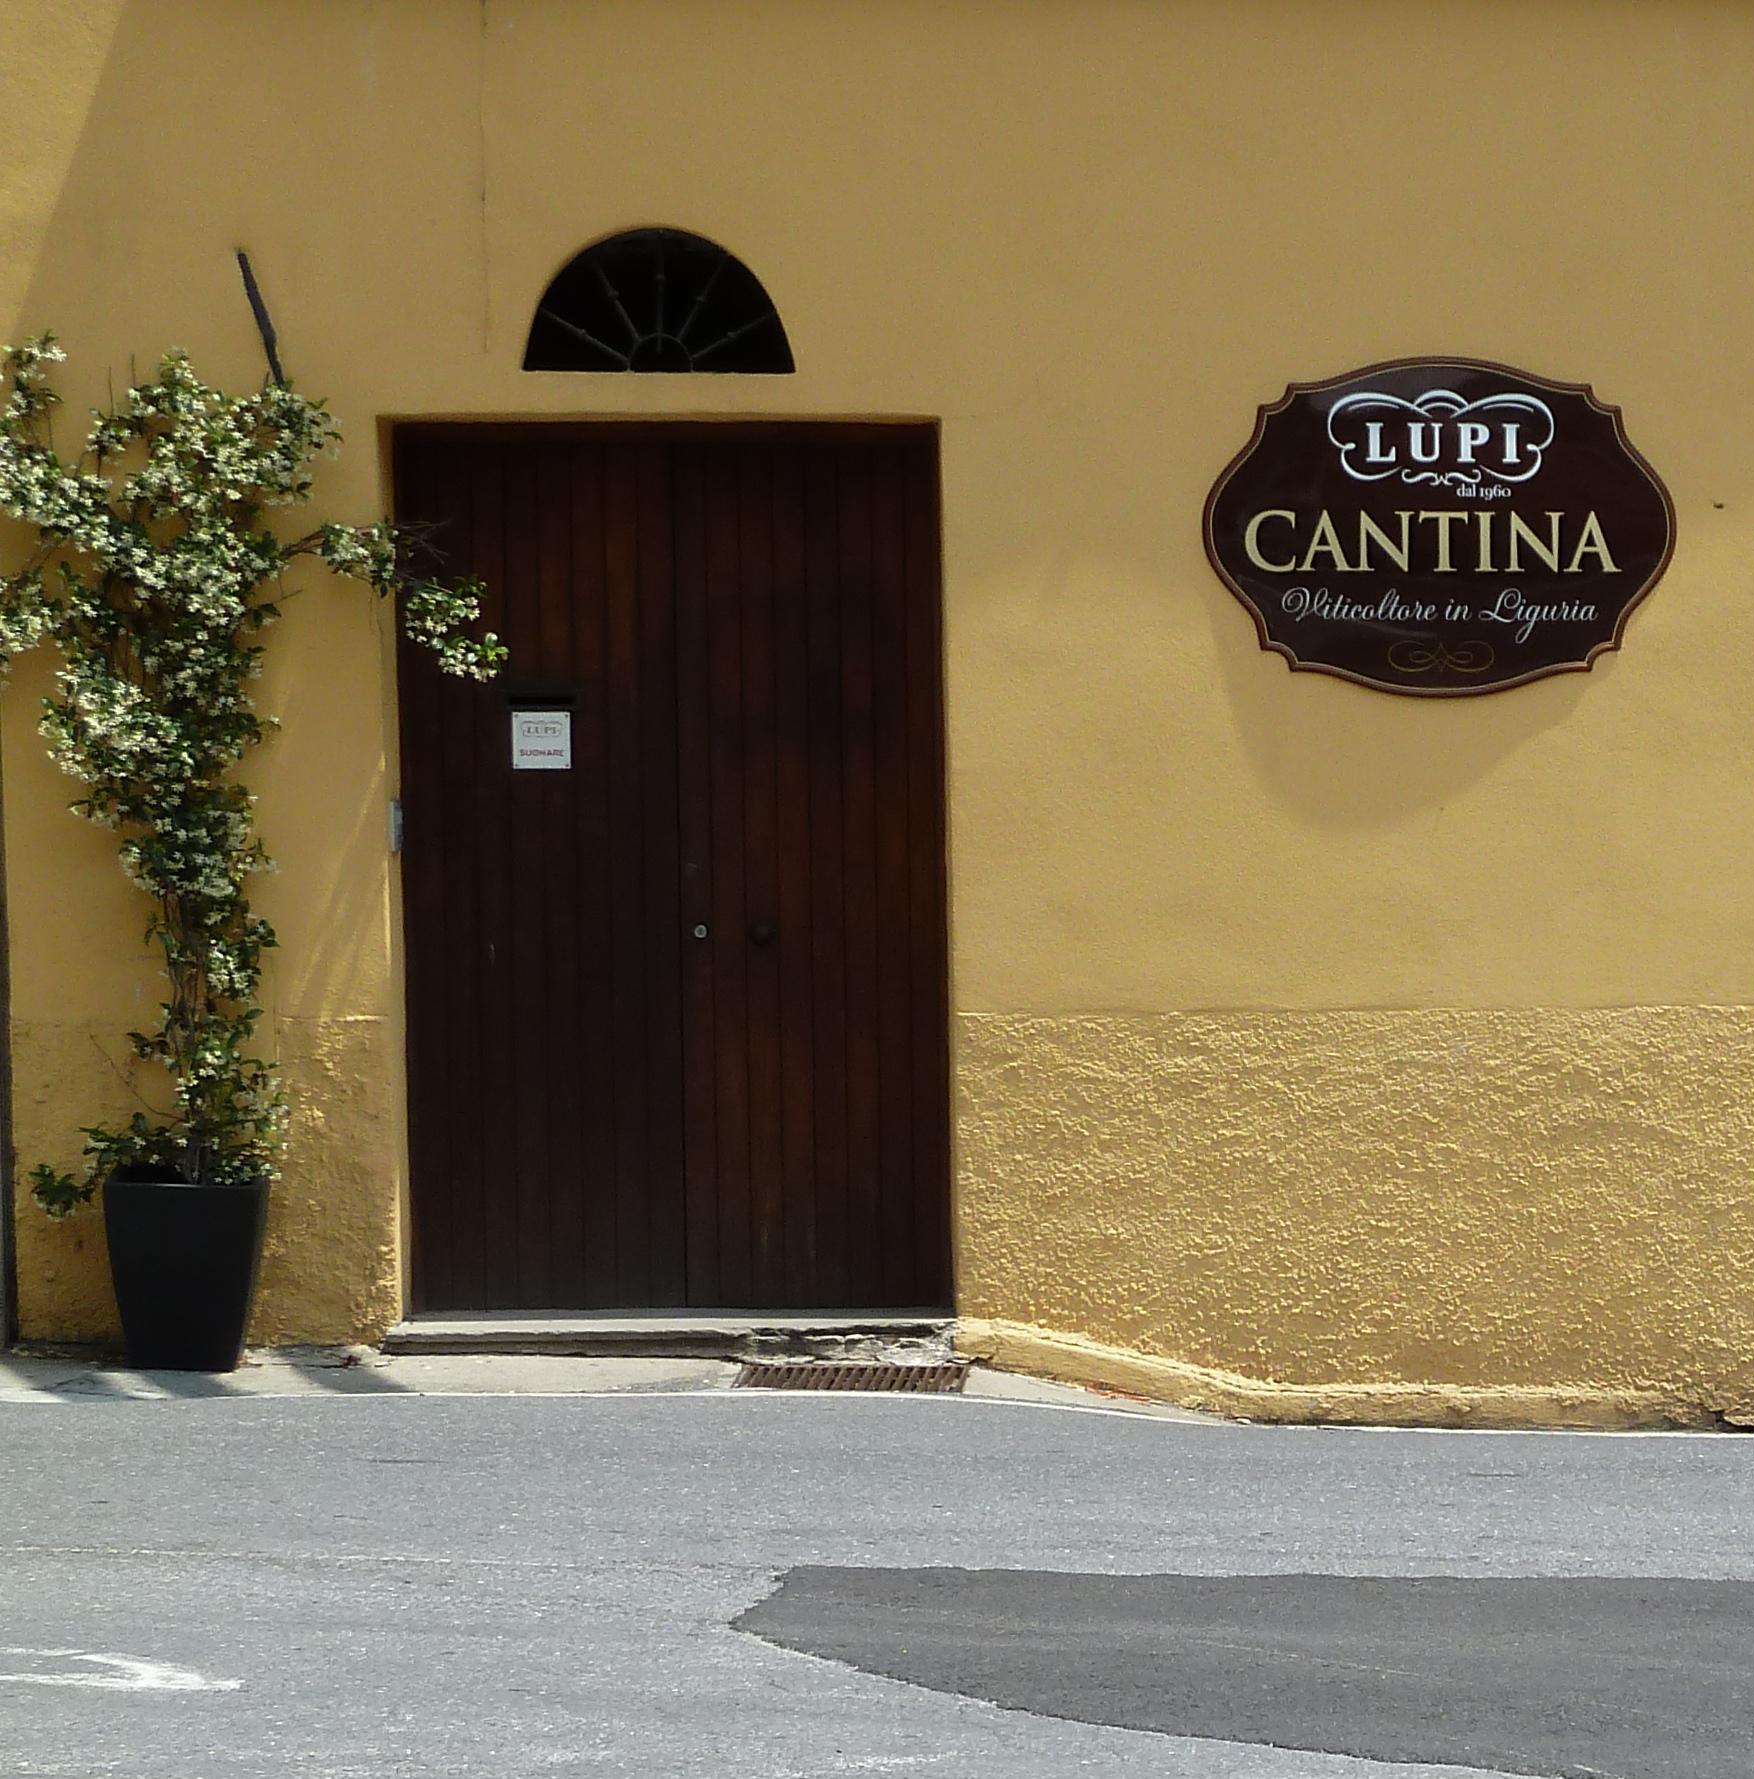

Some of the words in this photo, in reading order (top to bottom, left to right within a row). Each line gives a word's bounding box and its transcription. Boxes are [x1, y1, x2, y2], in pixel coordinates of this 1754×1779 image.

[1366, 422, 1521, 464] LUPI
[1456, 484, 1477, 498] dal
[1479, 486, 1511, 500] 1960
[1244, 510, 1621, 573] CANTINA
[1282, 587, 1436, 622] Viticoltore
[1445, 600, 1472, 621] in
[1479, 589, 1598, 644] Liguria
